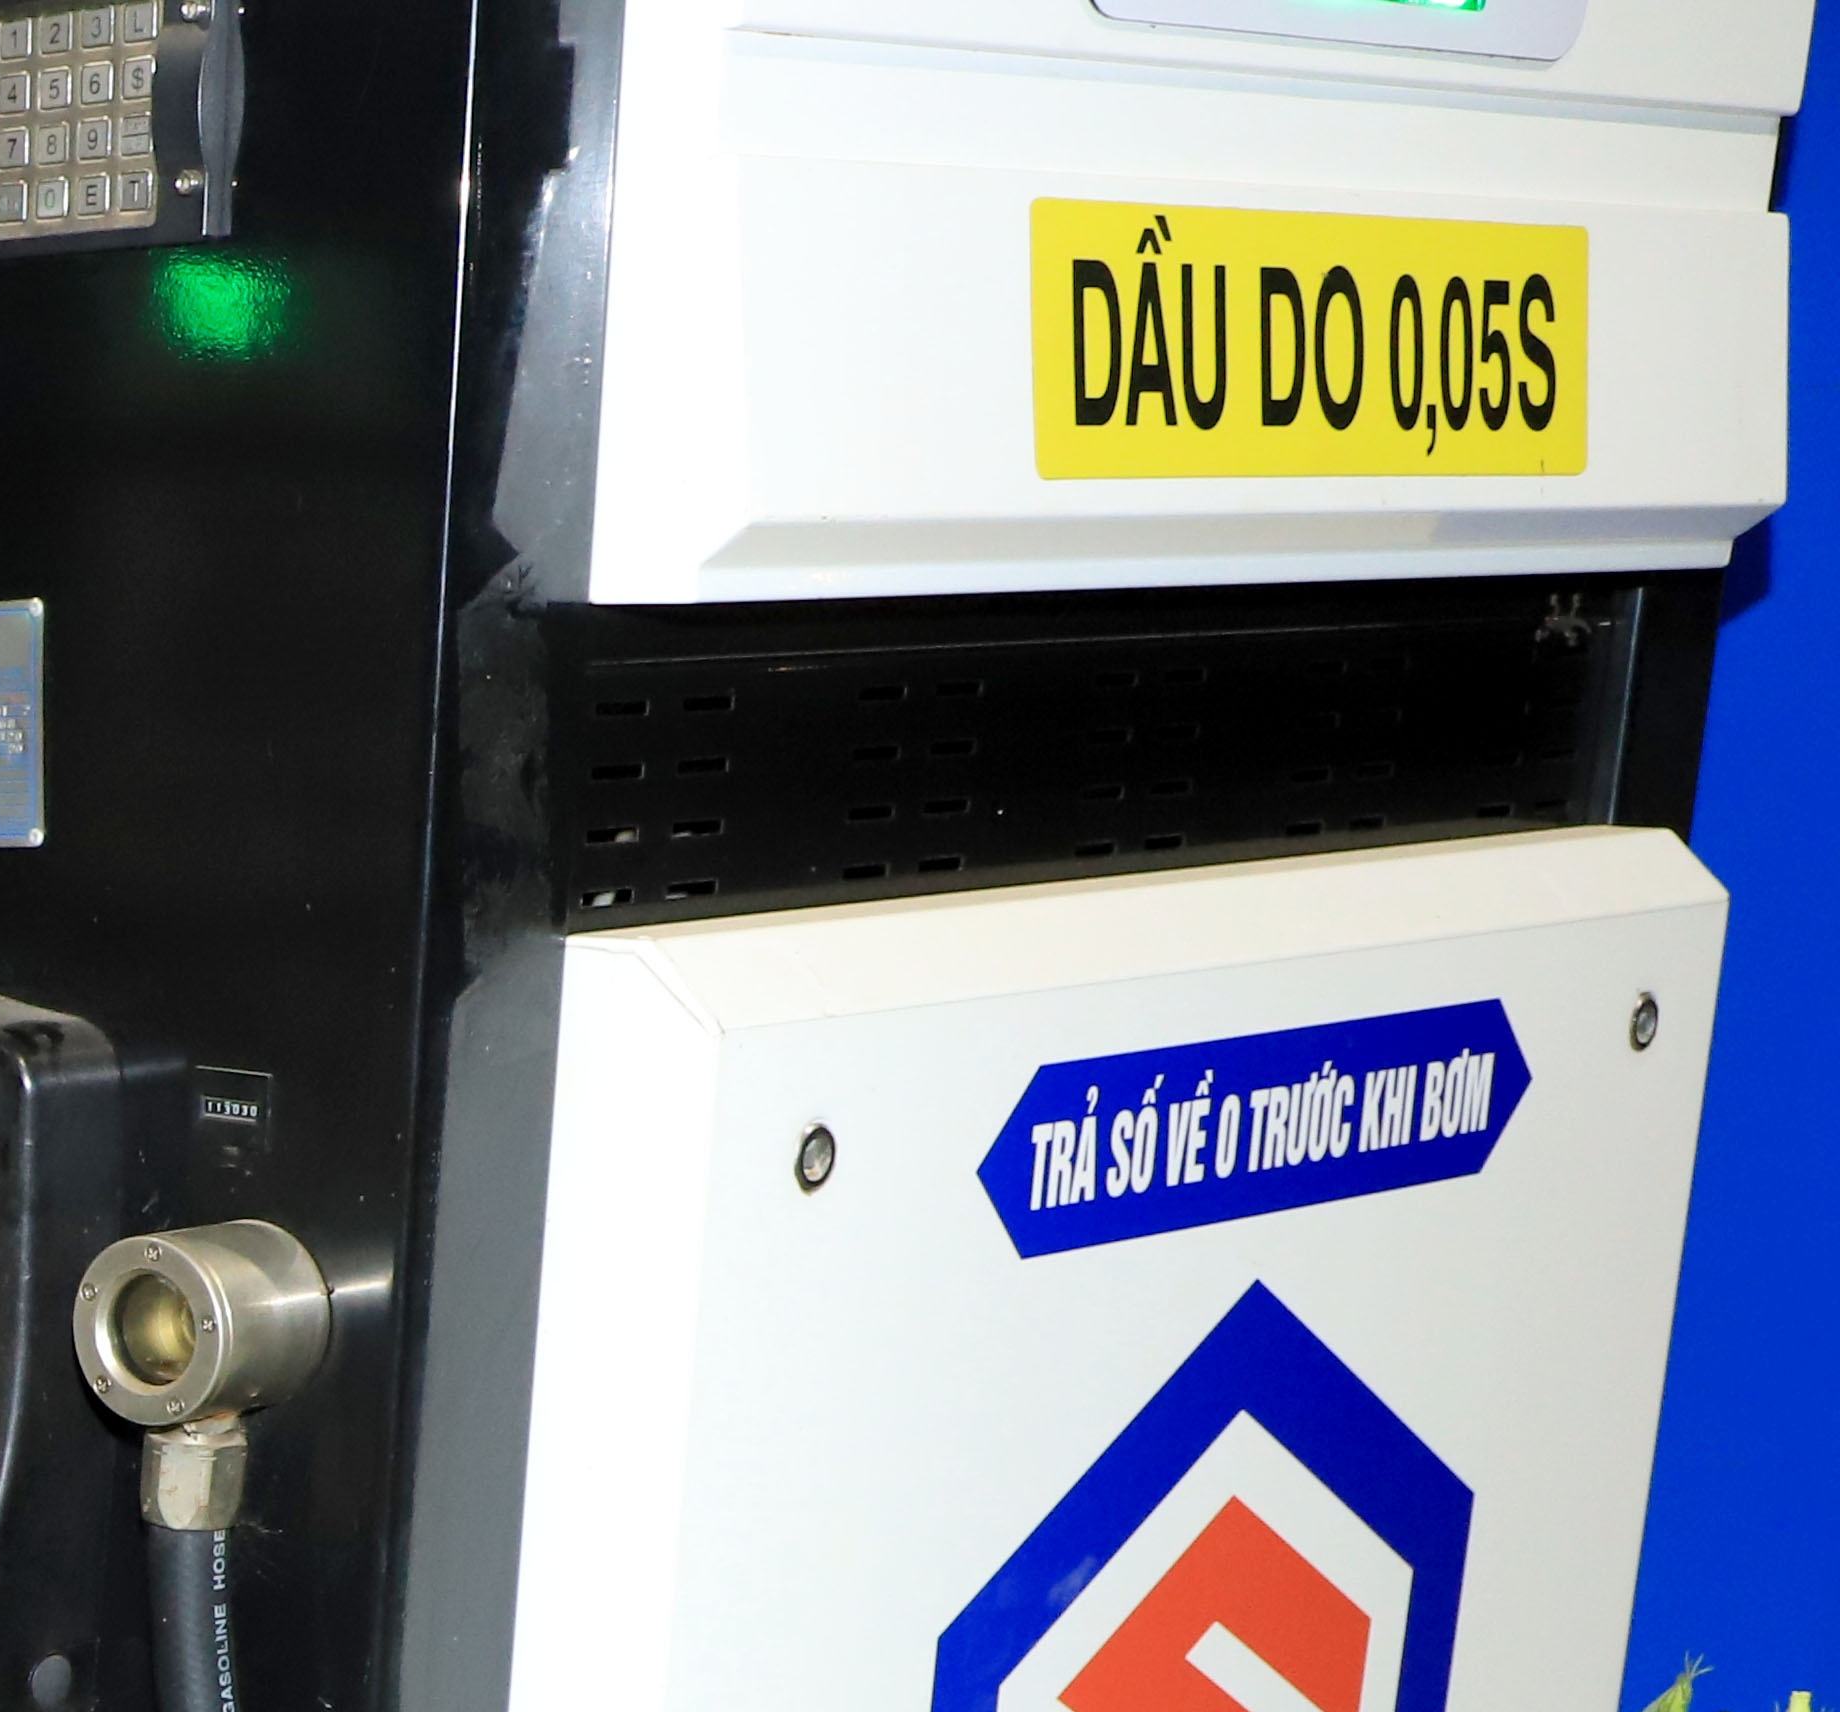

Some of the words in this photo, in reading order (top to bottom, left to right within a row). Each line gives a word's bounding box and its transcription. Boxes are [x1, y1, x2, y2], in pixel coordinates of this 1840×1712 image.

[11, 28, 19, 49] 1
[49, 22, 61, 45] 2
[90, 16, 102, 39] 3
[133, 10, 144, 33] L
[7, 83, 18, 104] 4
[49, 78, 60, 100] 5
[89, 73, 101, 95] 6
[131, 67, 144, 92] $
[7, 137, 18, 159] 7
[46, 134, 58, 156] 8
[87, 128, 99, 150] 9
[86, 184, 98, 206] E
[128, 180, 141, 202] T
[1071, 215, 1228, 431] DẦU
[1259, 264, 1365, 431] DO
[1389, 272, 1557, 456] 0,05S
[1029, 1084, 1099, 1211] TRẢ
[1105, 1073, 1165, 1199] SỐ
[1165, 1069, 1215, 1188] VỀ
[1247, 1060, 1356, 1173] TRƯỚC
[1357, 1064, 1419, 1153] KHI
[1418, 1048, 1497, 1143] BƠM
[212, 1529, 227, 1591] HOSE
